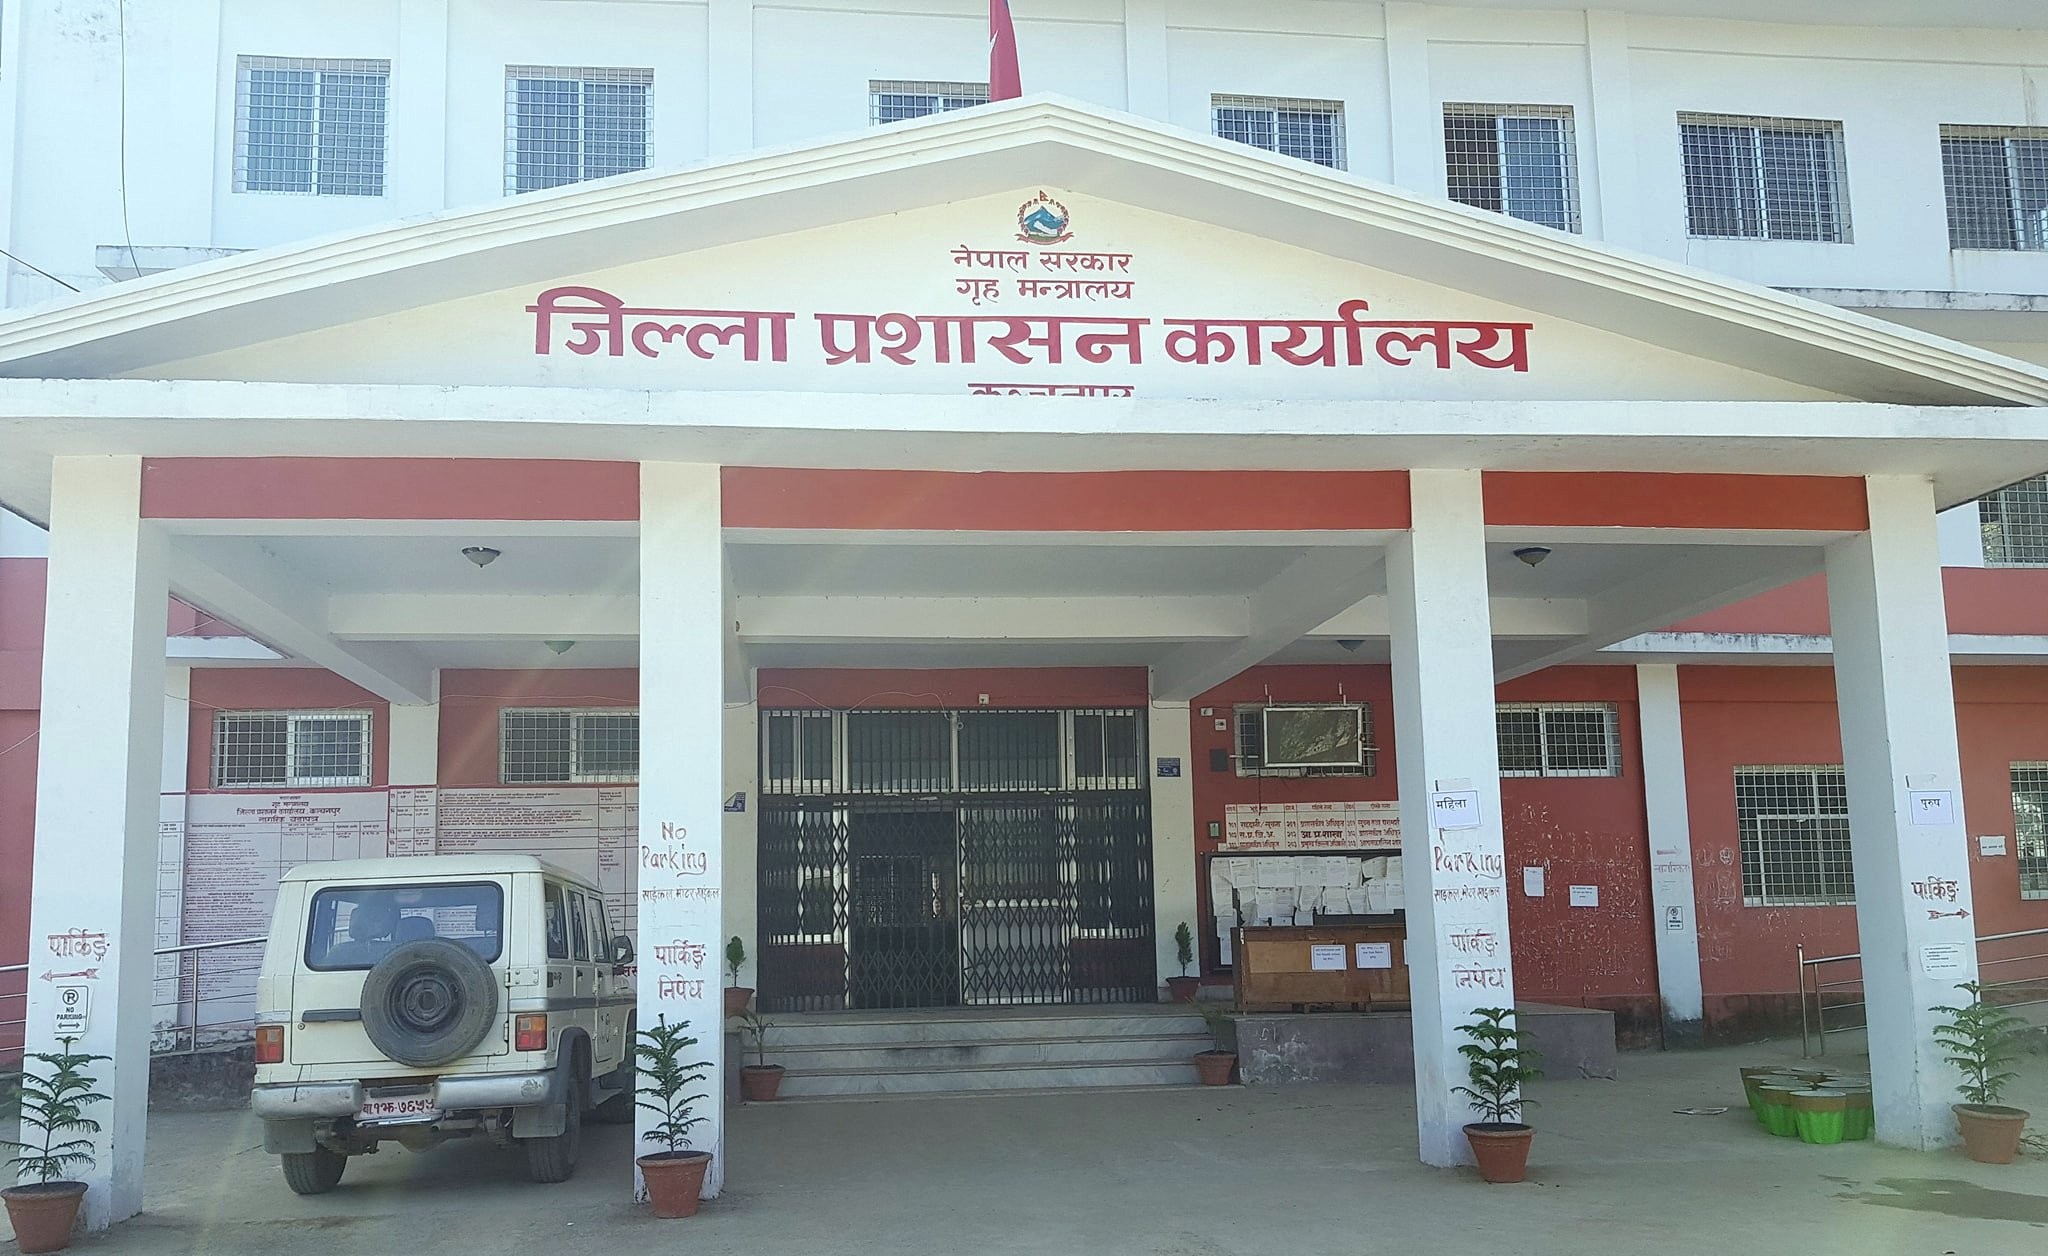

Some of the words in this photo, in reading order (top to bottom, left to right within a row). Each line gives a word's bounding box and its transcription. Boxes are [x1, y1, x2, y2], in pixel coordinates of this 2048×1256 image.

[950, 244, 1030, 273] नेपाल
[1039, 251, 1133, 274] सरकार
[955, 279, 1000, 306] गृह
[1016, 279, 1135, 302] मन्त्रालय
[525, 286, 795, 363] जिल्ला
[814, 312, 1150, 367] प्रशासन
[1164, 299, 1534, 372] कार्यालय
[1435, 796, 1467, 811] महिला
[661, 821, 687, 840] No
[641, 843, 707, 878] Parking
[1434, 845, 1503, 880] Parking
